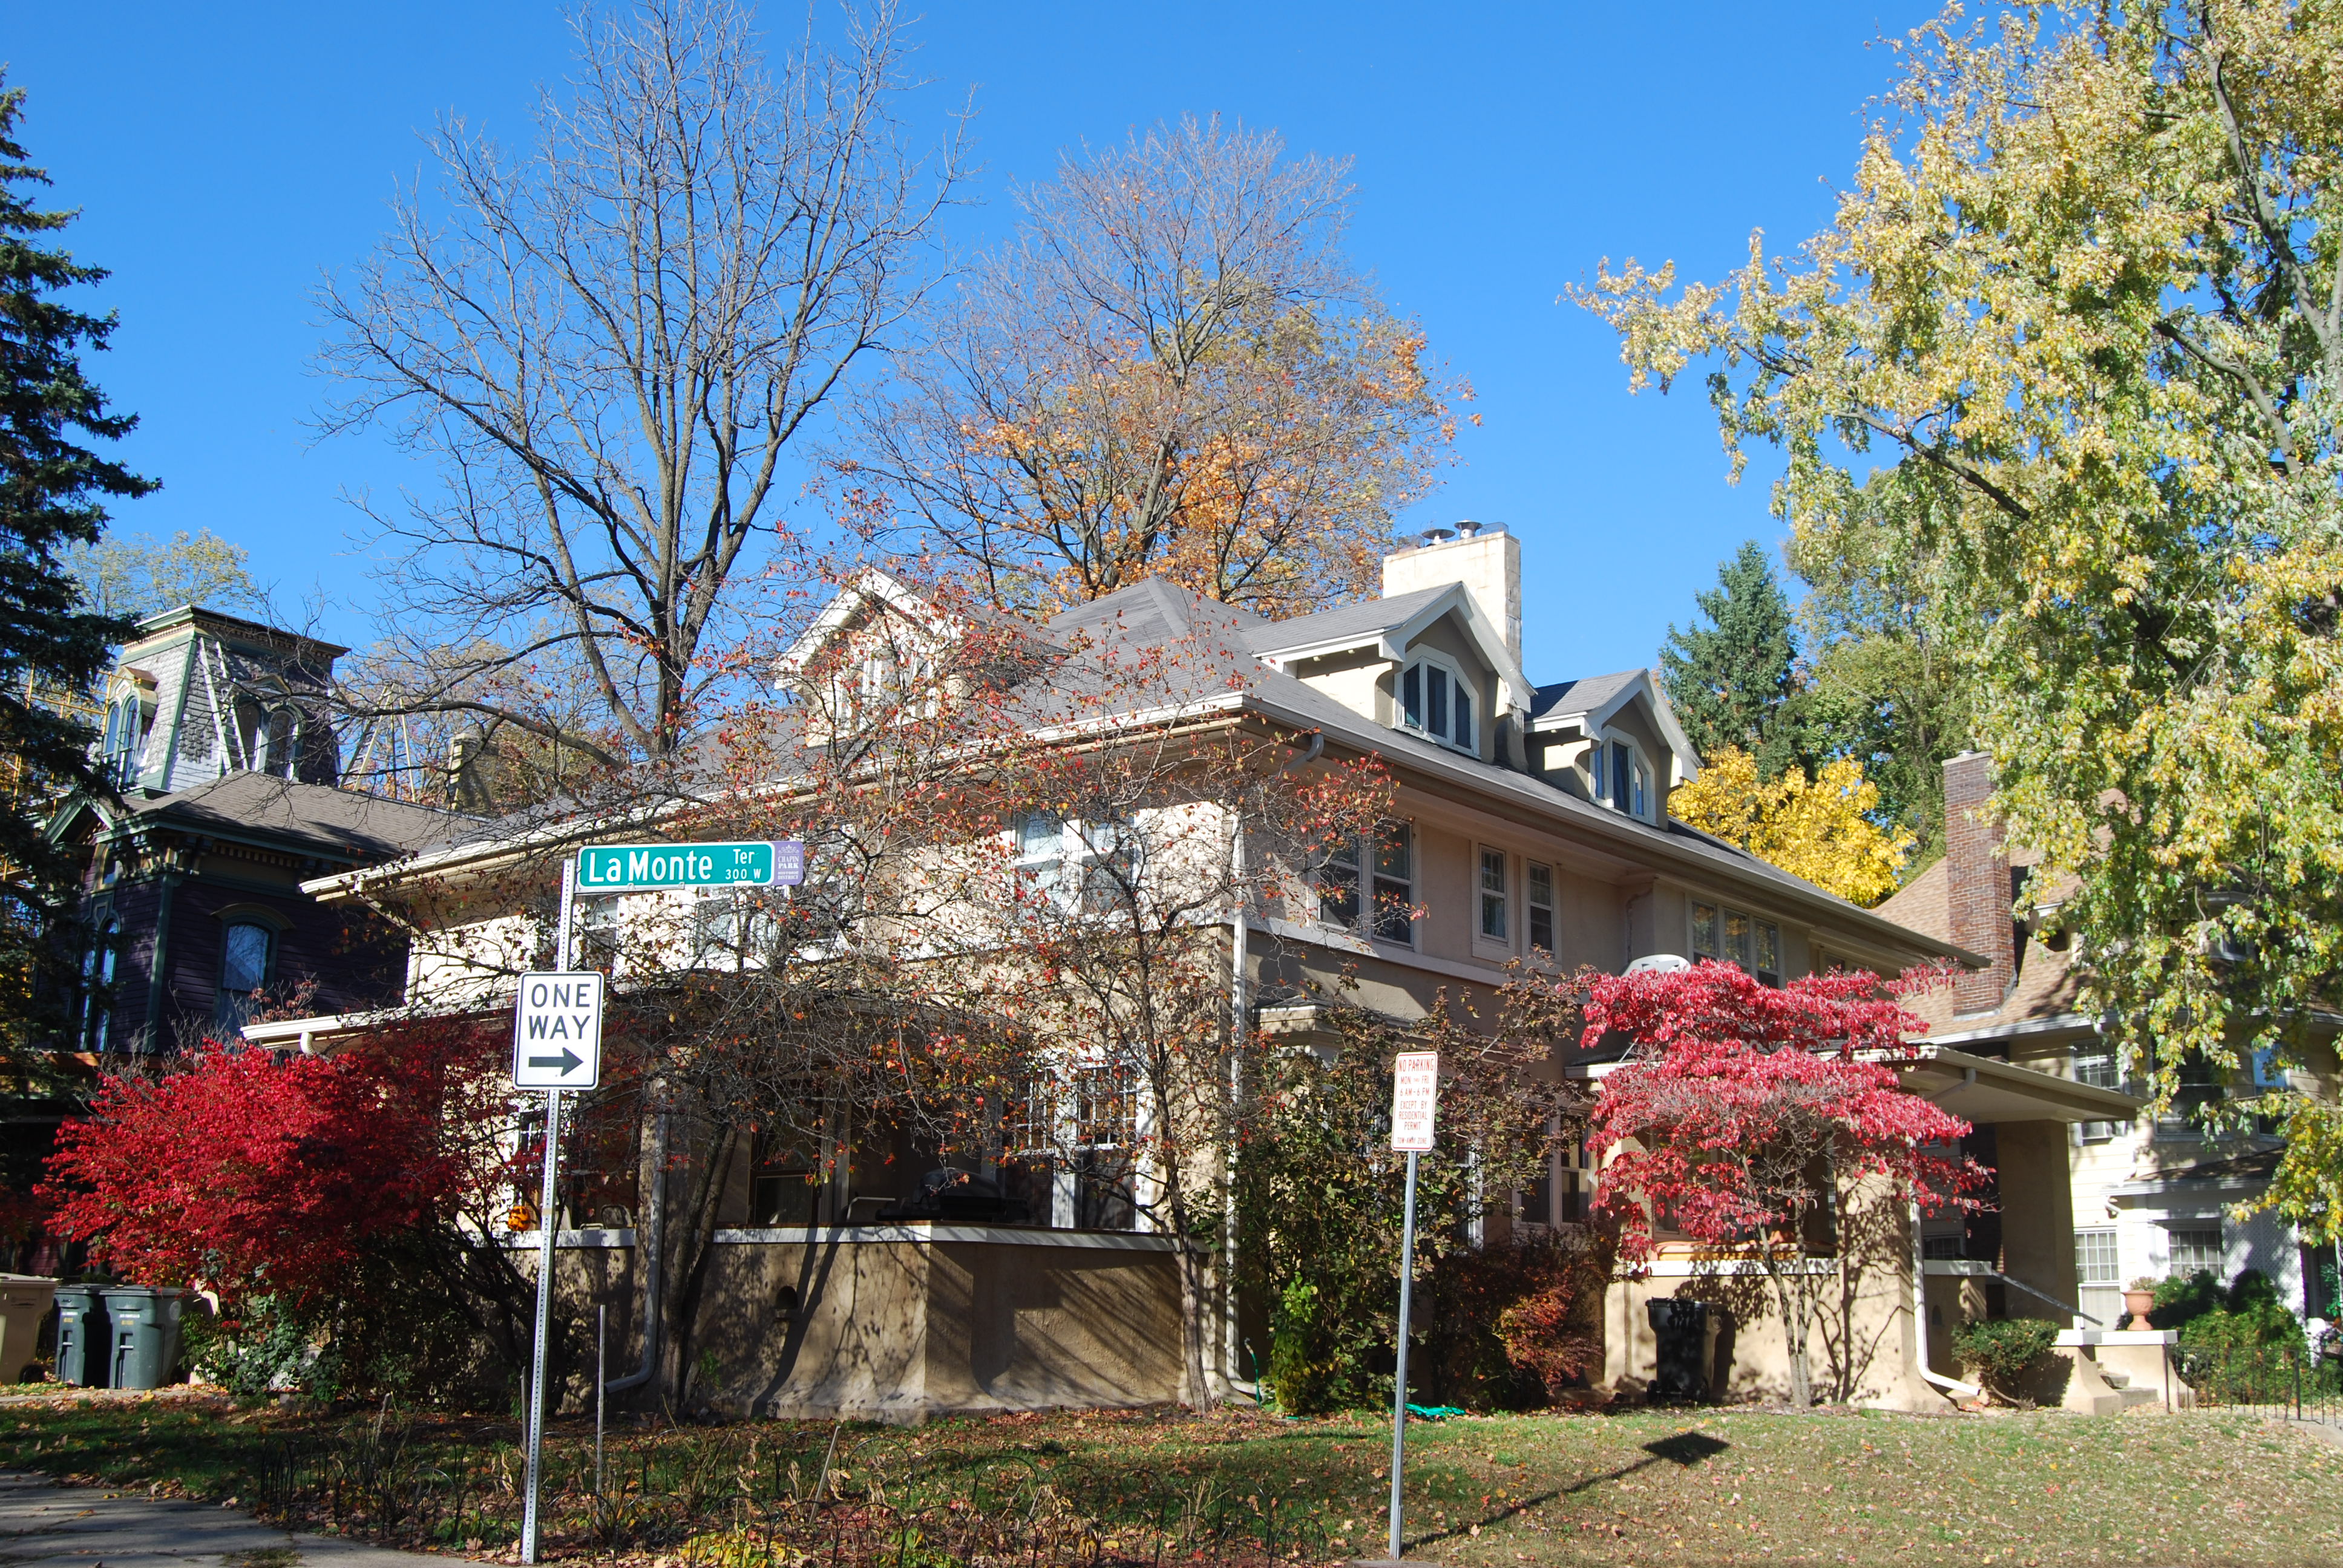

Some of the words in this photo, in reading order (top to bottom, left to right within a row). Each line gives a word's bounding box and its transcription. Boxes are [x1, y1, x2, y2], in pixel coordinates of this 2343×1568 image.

[733, 849, 755, 864] Ter
[726, 869, 747, 880] 300
[753, 868, 761, 878] W
[531, 983, 591, 1008] ONE
[528, 1015, 591, 1039] WAY
[1398, 1060, 1406, 1072] NO
[1408, 1059, 1434, 1071] PARKING
[1400, 1100, 1417, 1109] EXCEPT
[1421, 1100, 1427, 1109] BY
[1399, 1111, 1427, 1119] RESIDENTIAL
[1404, 1122, 1421, 1130] PERMIT
